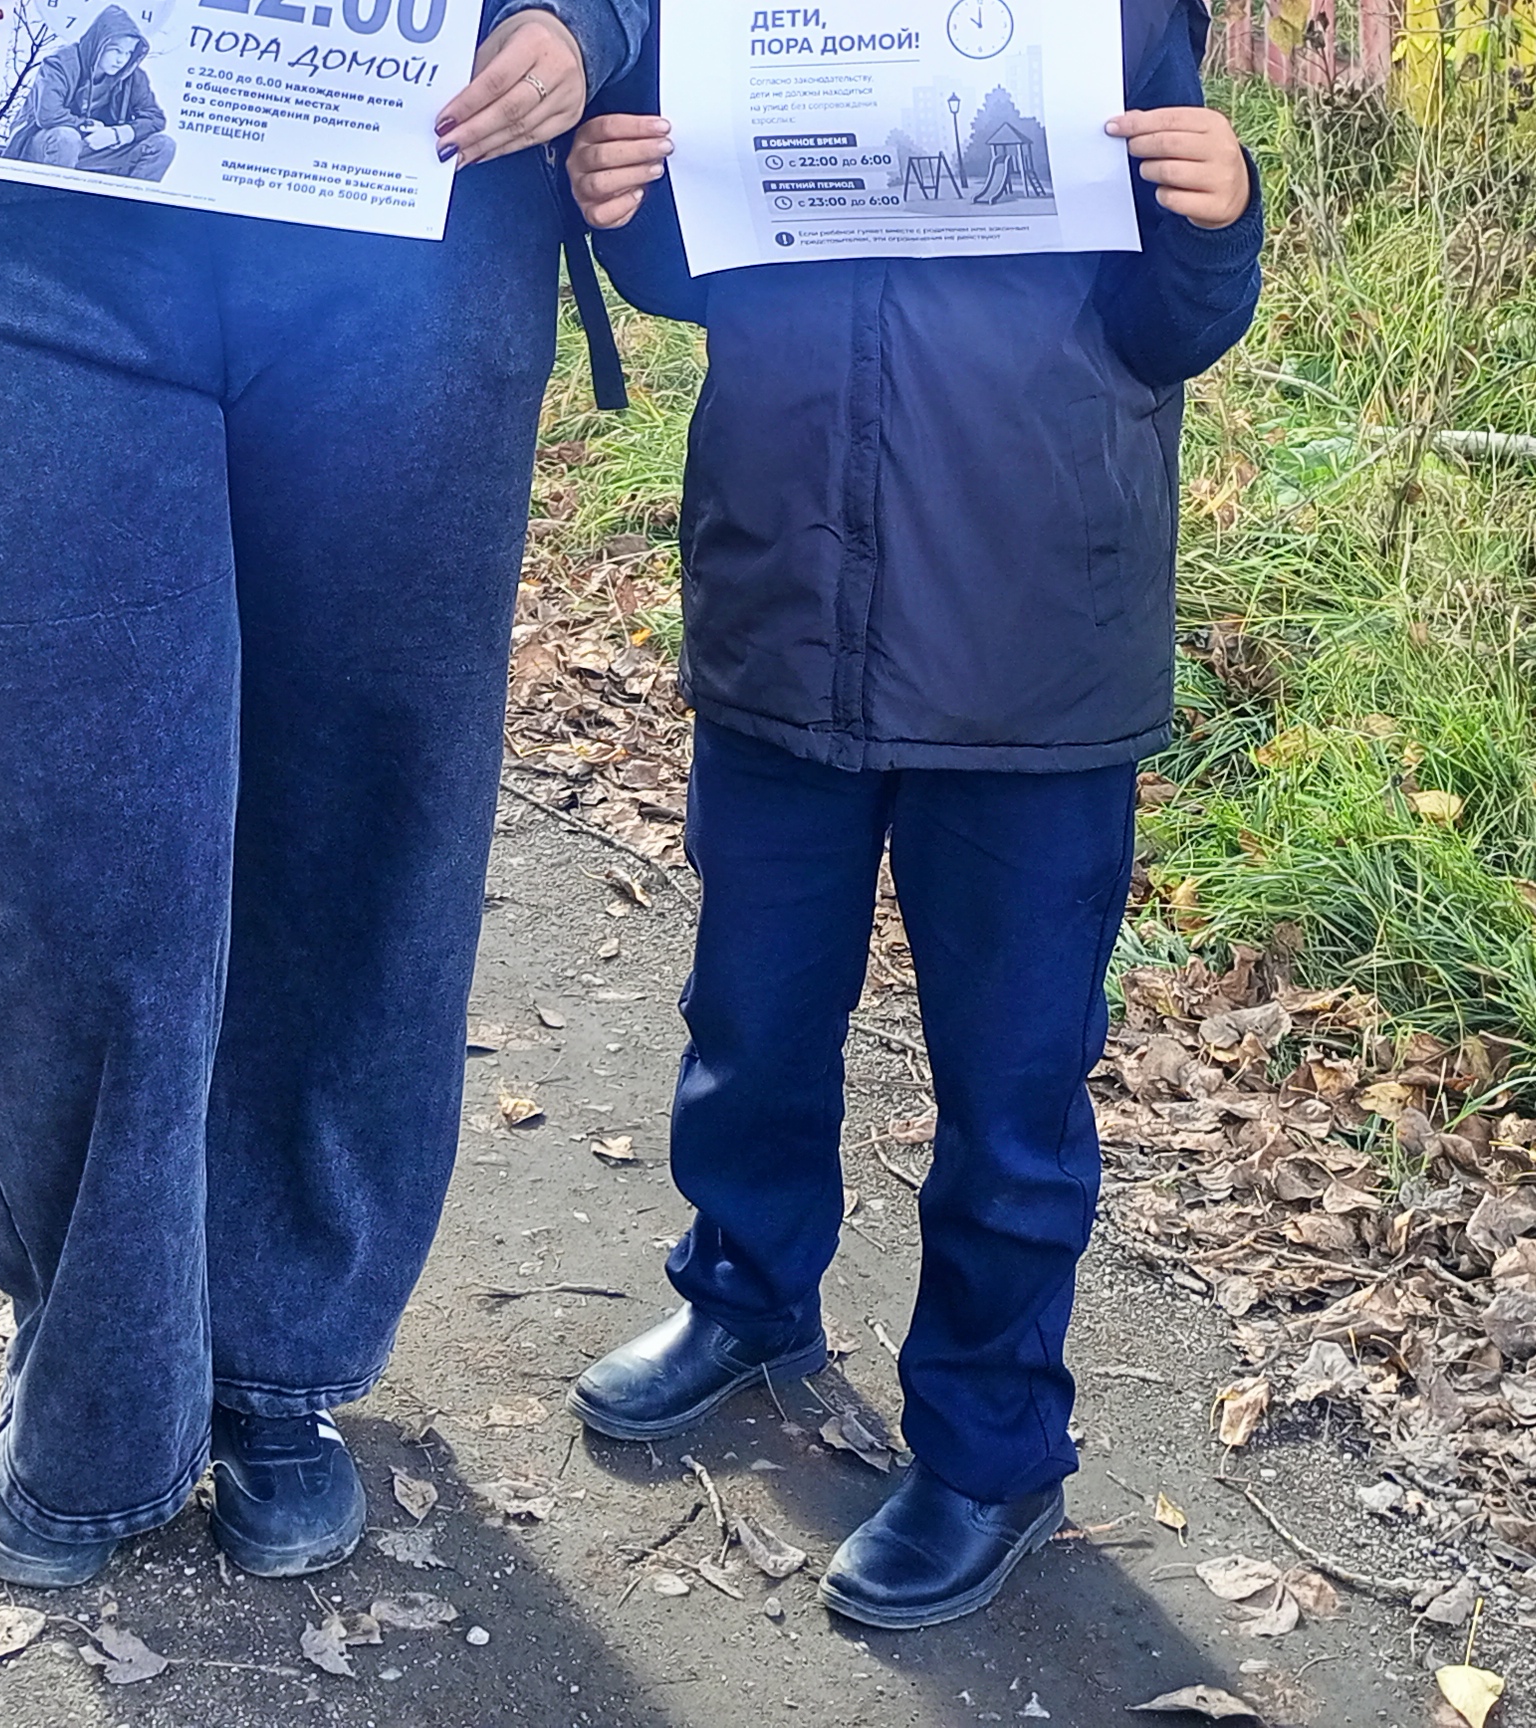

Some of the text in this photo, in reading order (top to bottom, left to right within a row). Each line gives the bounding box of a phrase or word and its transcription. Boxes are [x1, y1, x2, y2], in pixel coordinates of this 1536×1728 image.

[65, 16, 77, 29] 7
[142, 10, 153, 23] 4
[750, 8, 827, 32] ДЕТИ,
[751, 27, 920, 56] ПОРА ДОМОЙ!
[189, 25, 439, 87] ПОРА ДОМОЙ!
[187, 67, 404, 108] с 22.00 до 6.00 нахождение детей
[750, 76, 792, 87] Согласно
[185, 80, 340, 112] в общественных местах
[750, 90, 770, 100] дети
[785, 89, 821, 99] должны
[822, 87, 873, 97] находиться
[183, 93, 381, 133] без сопровождения родителей
[750, 100, 878, 114] на улице без сопровождения
[180, 108, 268, 129] или опекунов
[178, 120, 265, 142] ЗАПРЕЩЕНО!
[761, 136, 848, 147] В ОБЫЧНОЕ ВРЕМЯ
[313, 159, 328, 170] за
[332, 162, 402, 180] нарушение
[789, 155, 892, 168] с 22:00 до 6:00
[221, 159, 342, 185] административное
[345, 177, 419, 195] взыскание:
[770, 179, 856, 190] В ЛЕТНИЙ ПЕРИОД
[222, 173, 416, 209] штраф от 1000 до 5000 рублей
[798, 195, 900, 208] с 23:00 до 6:00
